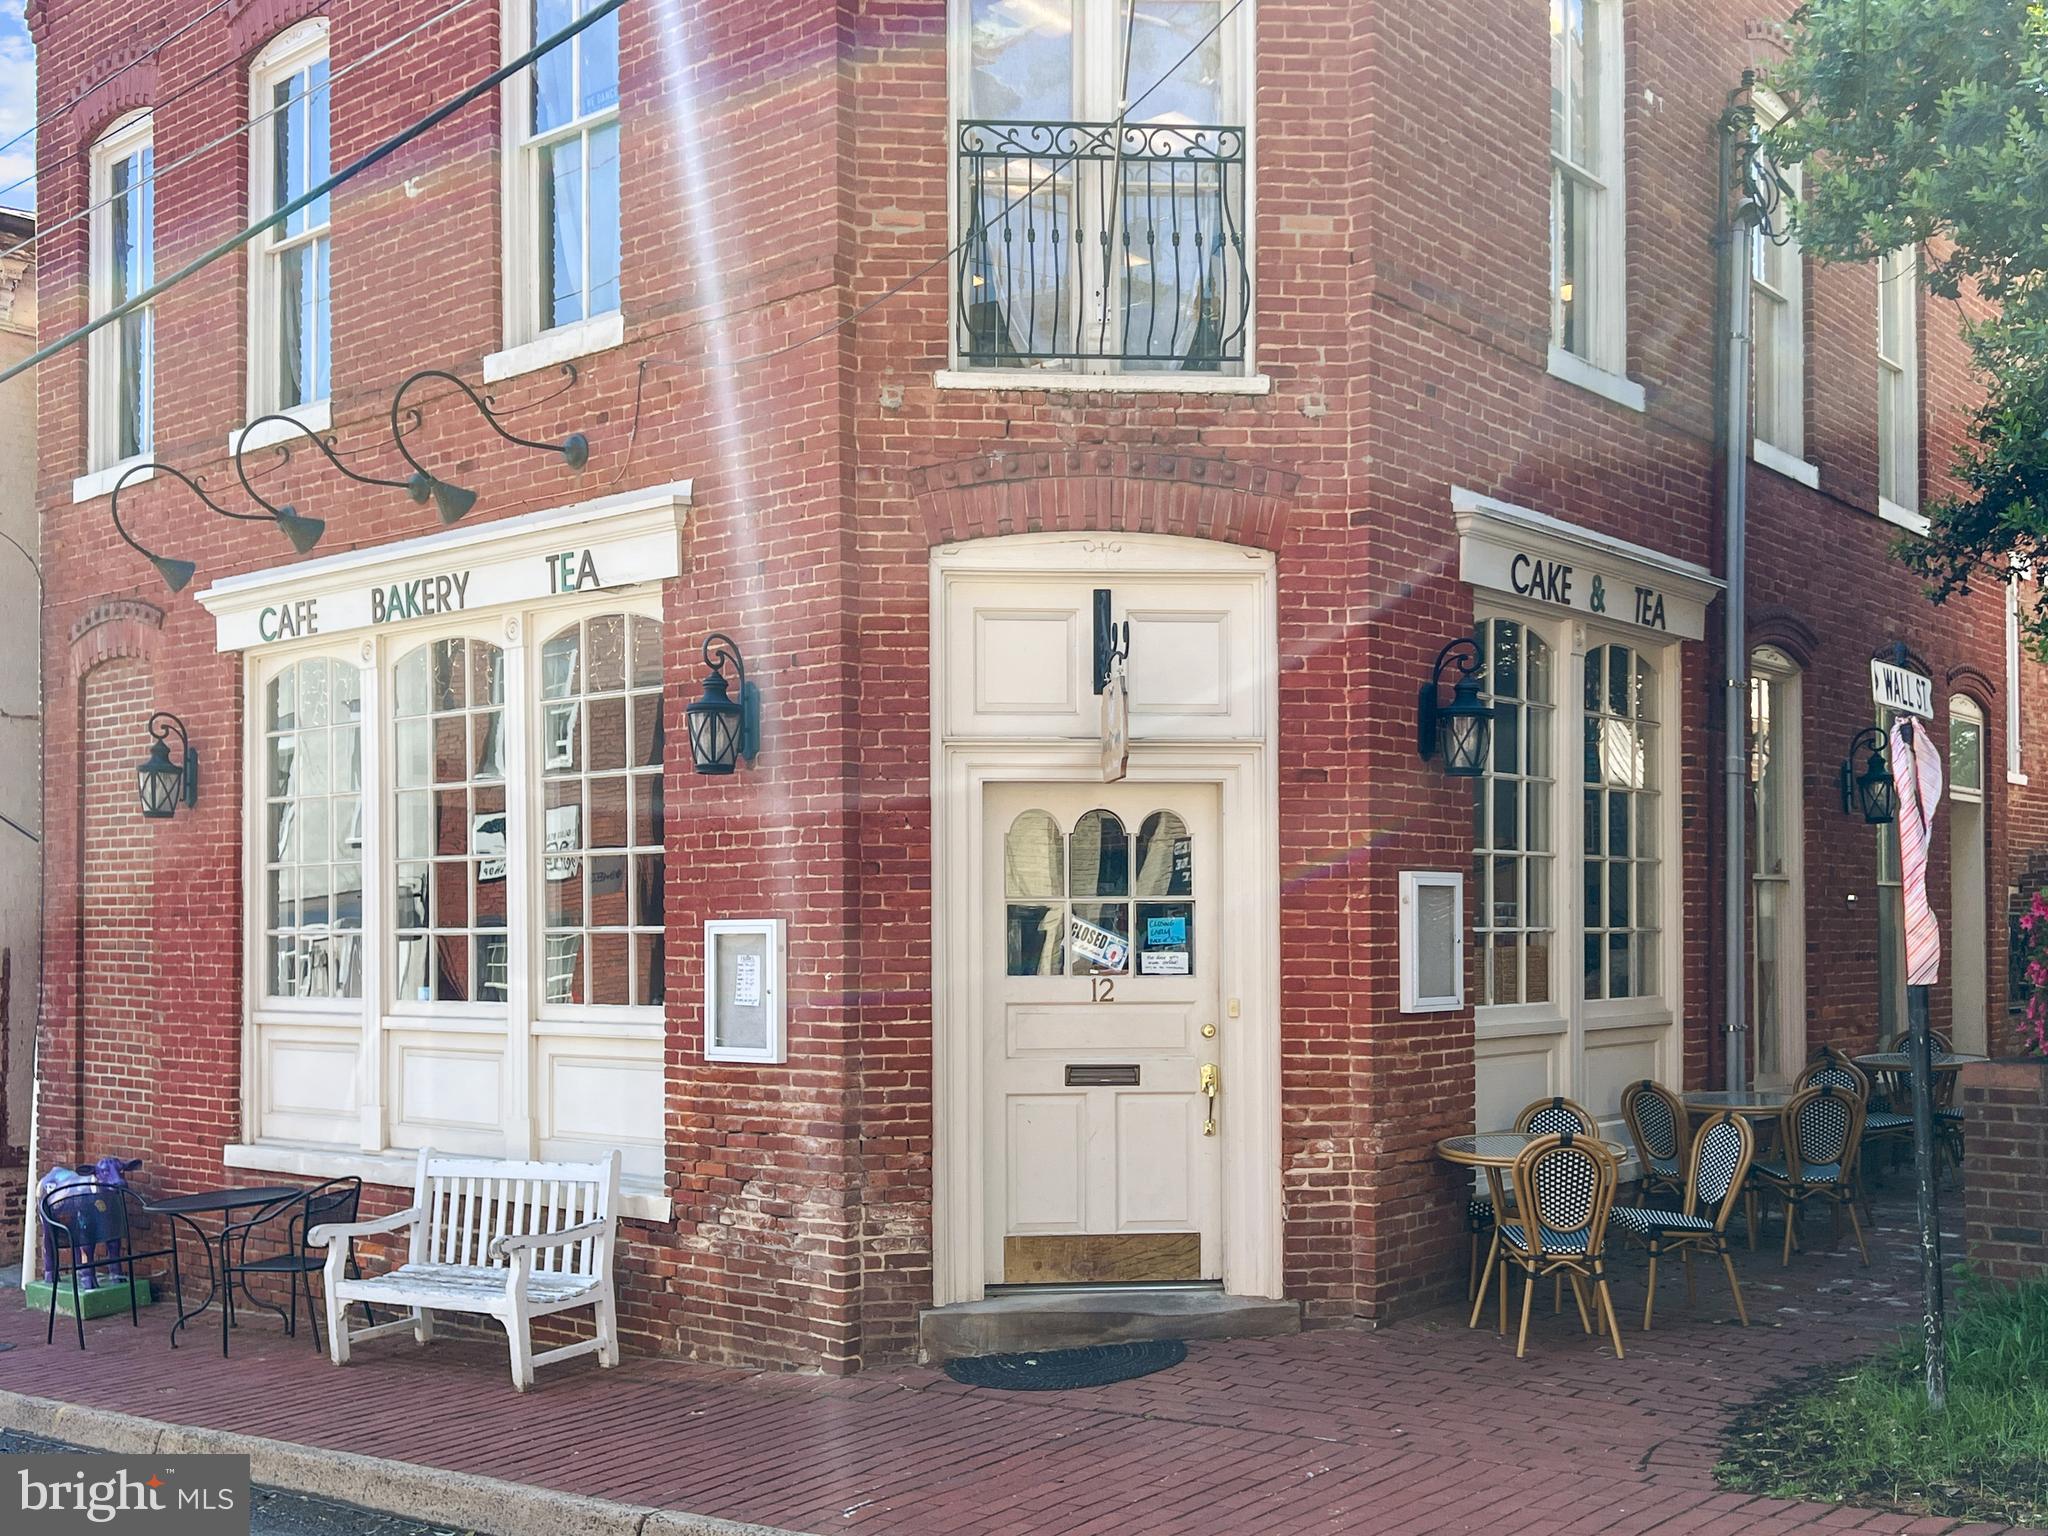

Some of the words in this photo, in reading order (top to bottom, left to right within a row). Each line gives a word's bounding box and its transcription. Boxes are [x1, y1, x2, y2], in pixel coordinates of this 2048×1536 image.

[259, 598, 318, 641] CAFE
[371, 571, 470, 623] BAKERY
[545, 549, 599, 594] TEA
[1511, 554, 1573, 605] CAKE
[1589, 575, 1606, 613] &
[1635, 587, 1666, 630] TEA
[1883, 668, 1914, 707] WALL
[1916, 678, 1928, 712] ST
[1071, 922, 1108, 949] CLOSED
[1091, 978, 1114, 1002] 12
